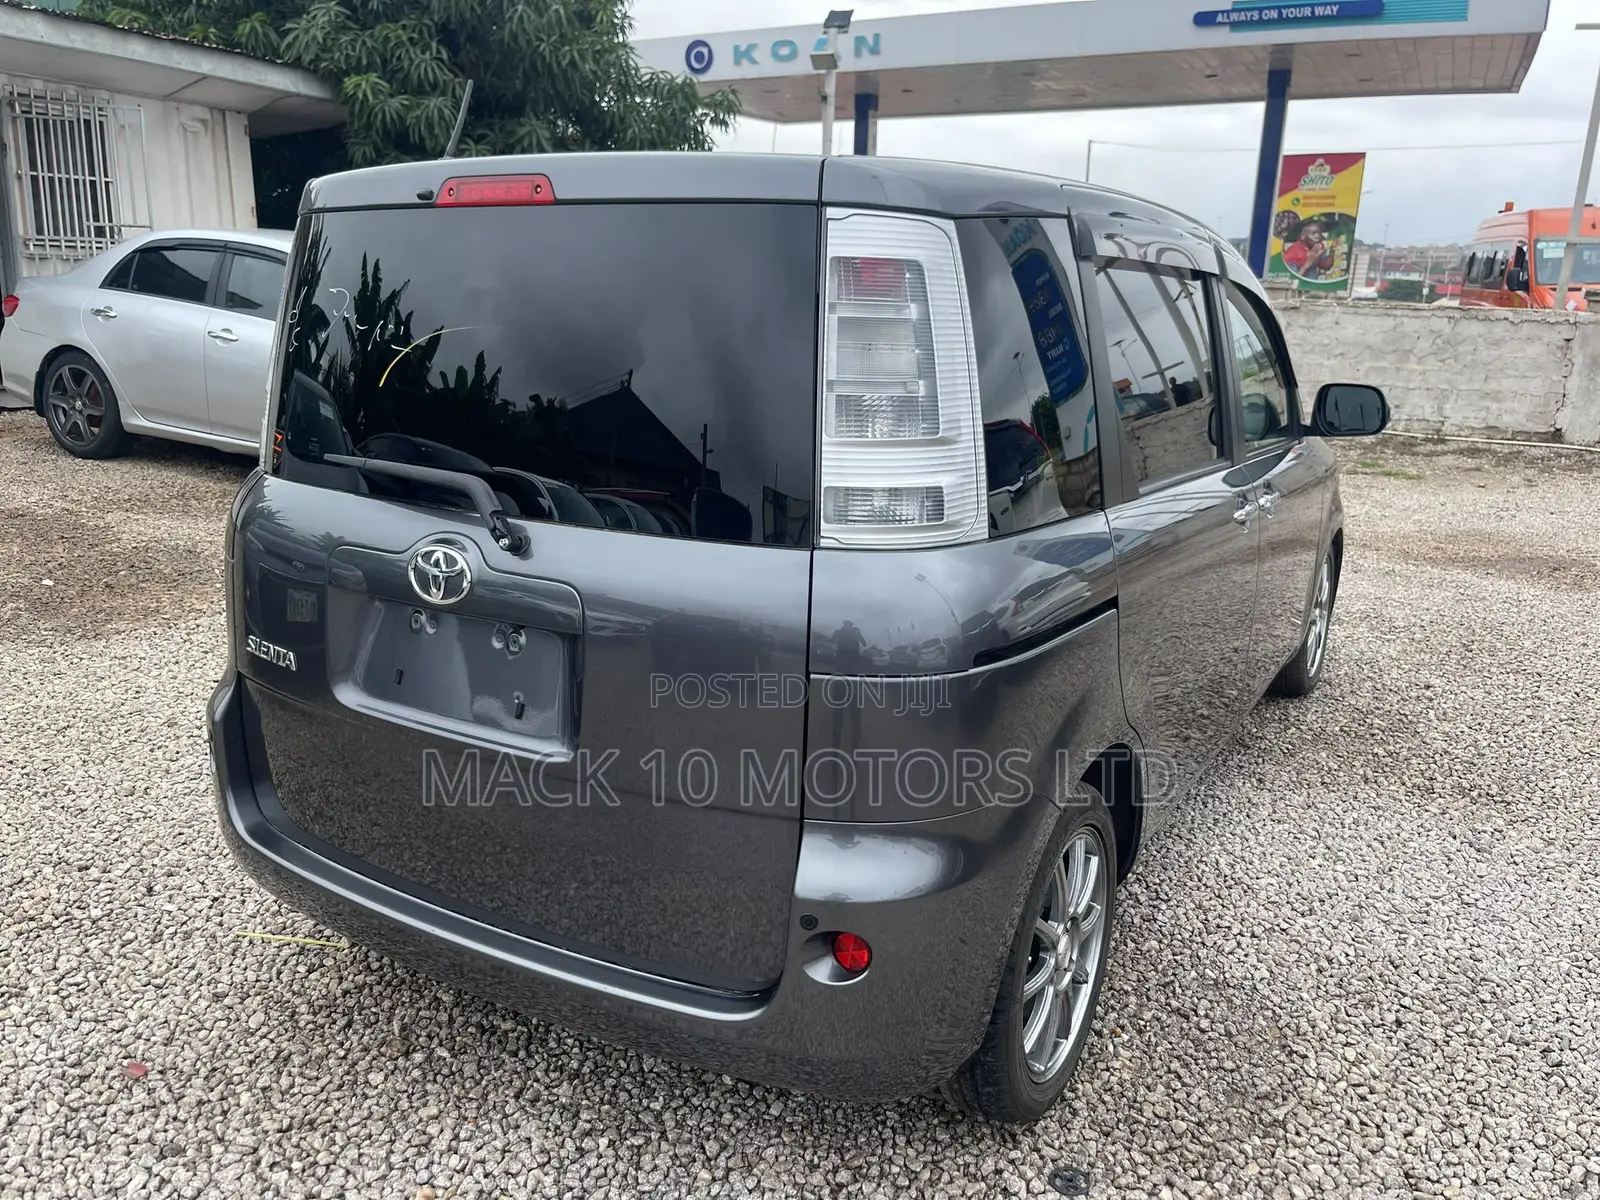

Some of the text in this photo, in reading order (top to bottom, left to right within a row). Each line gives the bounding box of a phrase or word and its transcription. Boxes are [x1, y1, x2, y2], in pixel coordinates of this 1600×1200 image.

[1215, 4, 1339, 23] ALWAYS ON YOUR WAY
[246, 635, 297, 671] SIENTA
